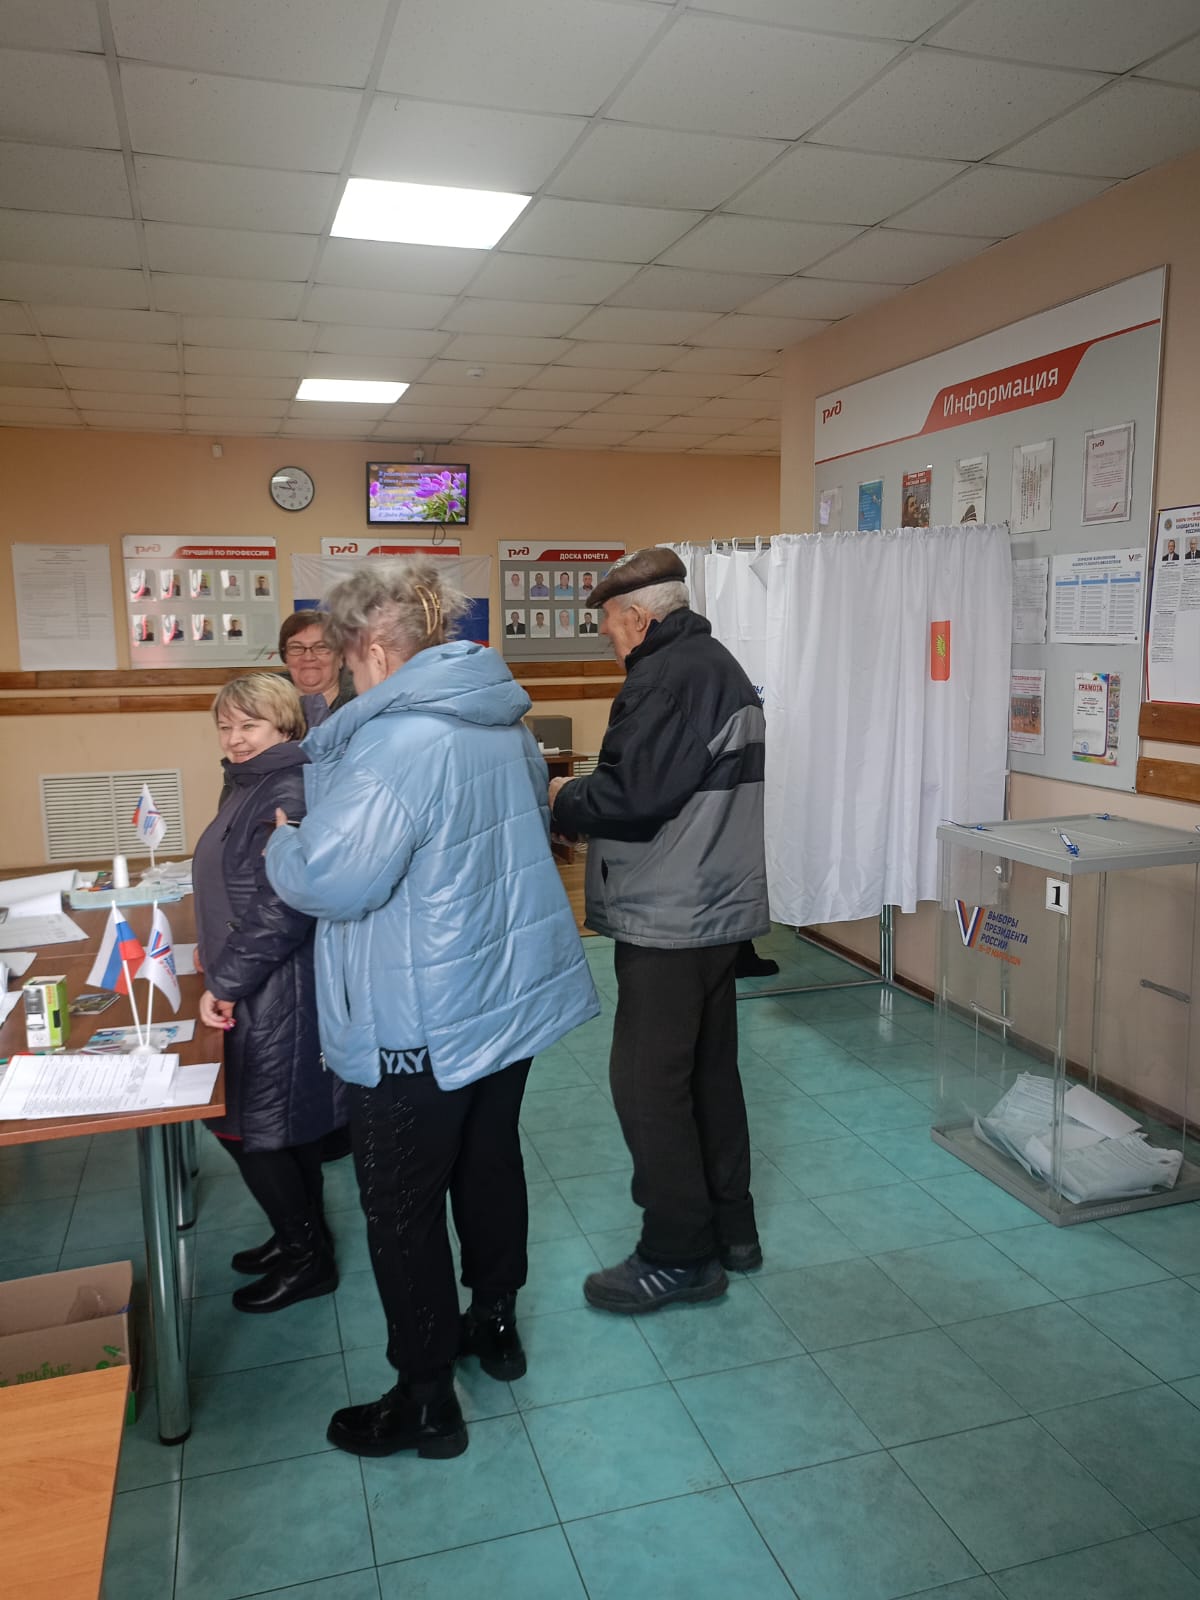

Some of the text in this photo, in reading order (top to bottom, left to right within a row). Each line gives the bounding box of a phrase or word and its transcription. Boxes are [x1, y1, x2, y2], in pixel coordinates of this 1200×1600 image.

[943, 367, 1059, 417] Информация
[214, 549, 226, 557] ПО
[582, 552, 609, 560] ПОЧЁТА
[1078, 683, 1103, 693] ГРАМОТА
[1051, 885, 1064, 908] 1
[987, 911, 1019, 928] ВЫБОРЫ
[984, 922, 1028, 944] ПРЕЗИДЕНТА
[980, 934, 1008, 950] РОССИИ
